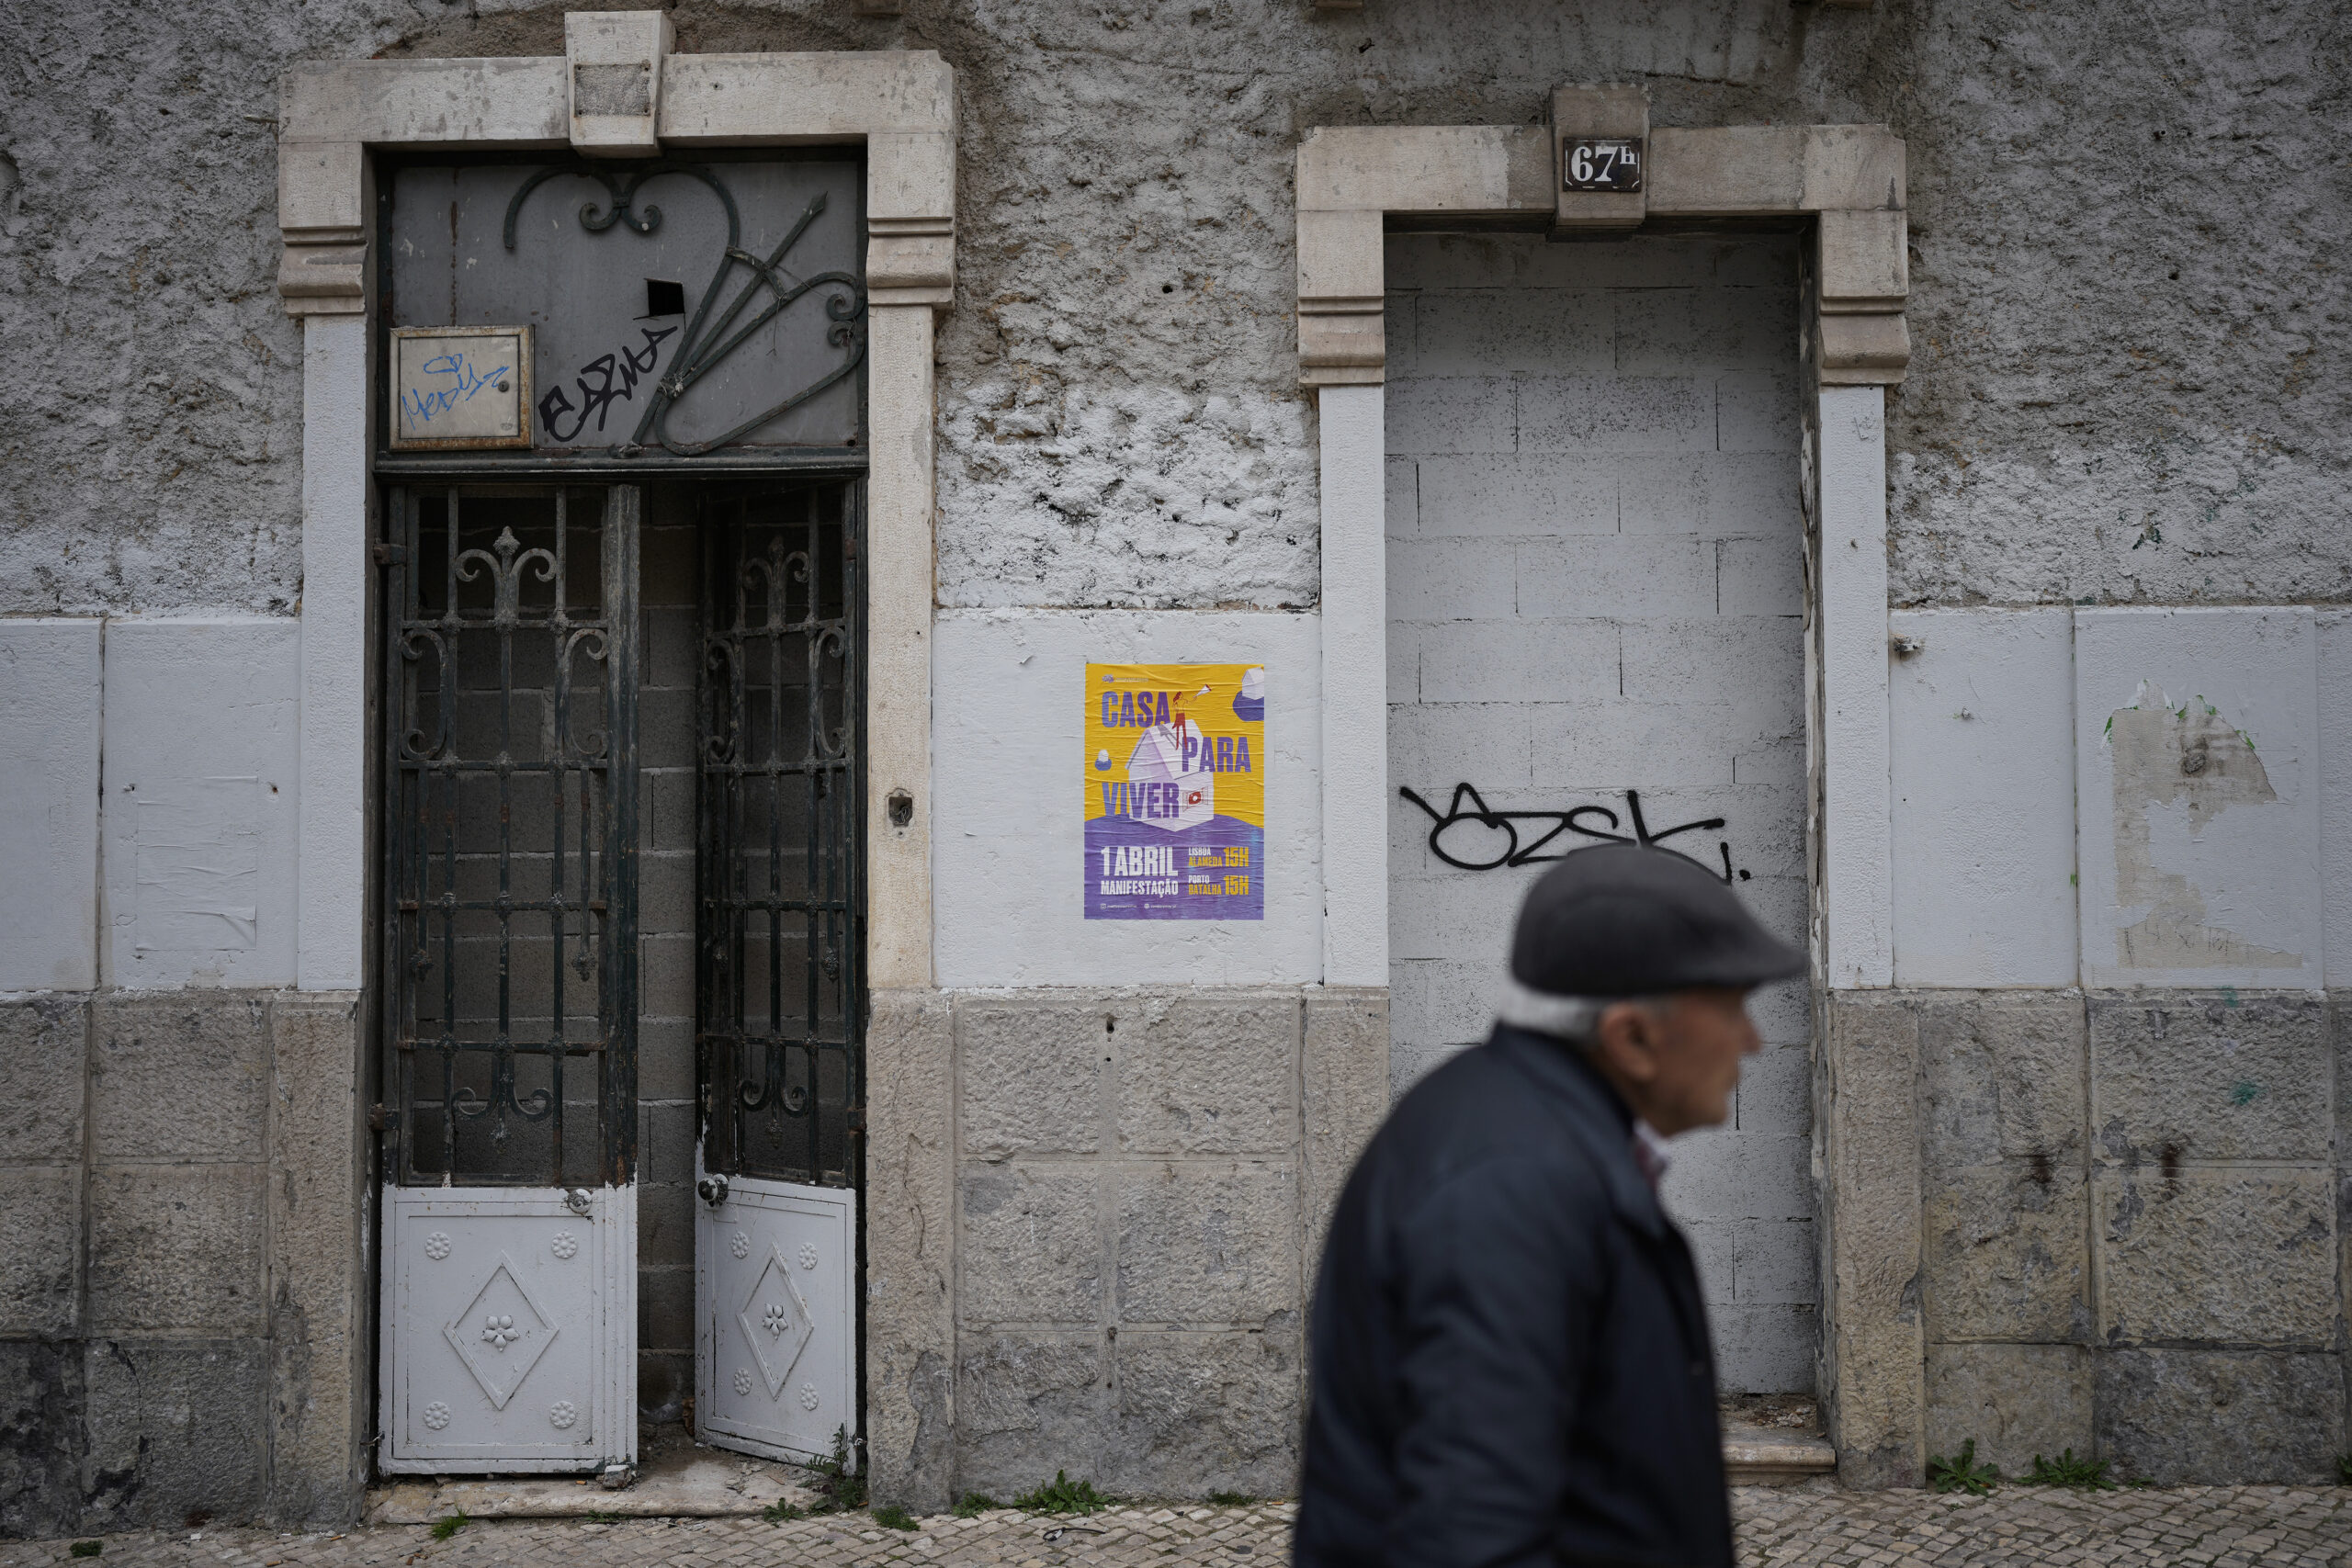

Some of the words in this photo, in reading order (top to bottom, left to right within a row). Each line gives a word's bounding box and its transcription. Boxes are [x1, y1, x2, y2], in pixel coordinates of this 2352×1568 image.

[1102, 691, 1170, 728] CASA
[1182, 737, 1251, 773] PARA
[1102, 782, 1180, 818] VIVER
[1101, 846, 1110, 876] 1
[1114, 846, 1179, 876] ABRIL
[1188, 847, 1212, 856] LISBOA
[1188, 856, 1223, 867] ALAMEDA
[1223, 847, 1250, 867] 15H
[1101, 878, 1179, 898] MANIFESTAÇÃO
[1188, 874, 1210, 884] PORTO
[1188, 884, 1222, 896] BATALHA
[1223, 874, 1250, 896] 15H
